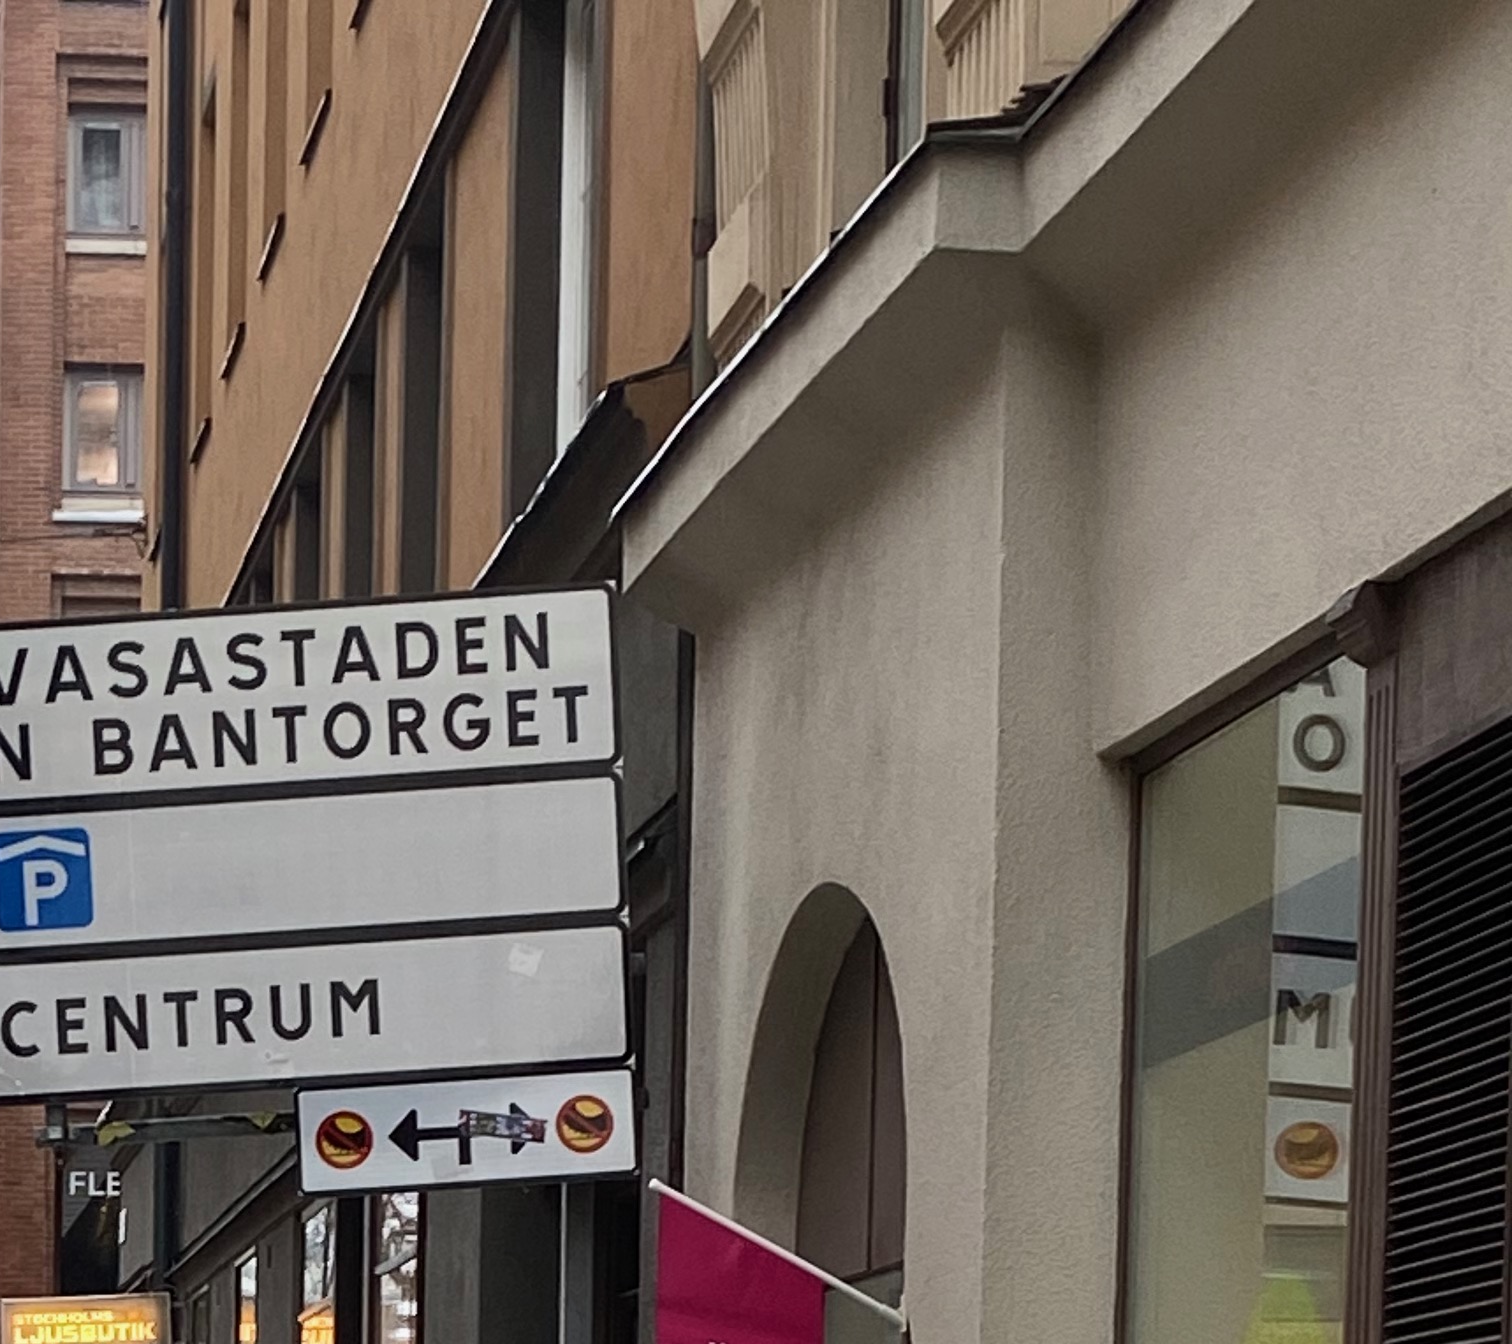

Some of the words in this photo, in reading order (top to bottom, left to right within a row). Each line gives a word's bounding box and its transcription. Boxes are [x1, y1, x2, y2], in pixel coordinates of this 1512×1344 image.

[93, 685, 588, 776] BANTORGET
[22, 859, 69, 926] P
[1, 979, 381, 1057] CENTRUM
